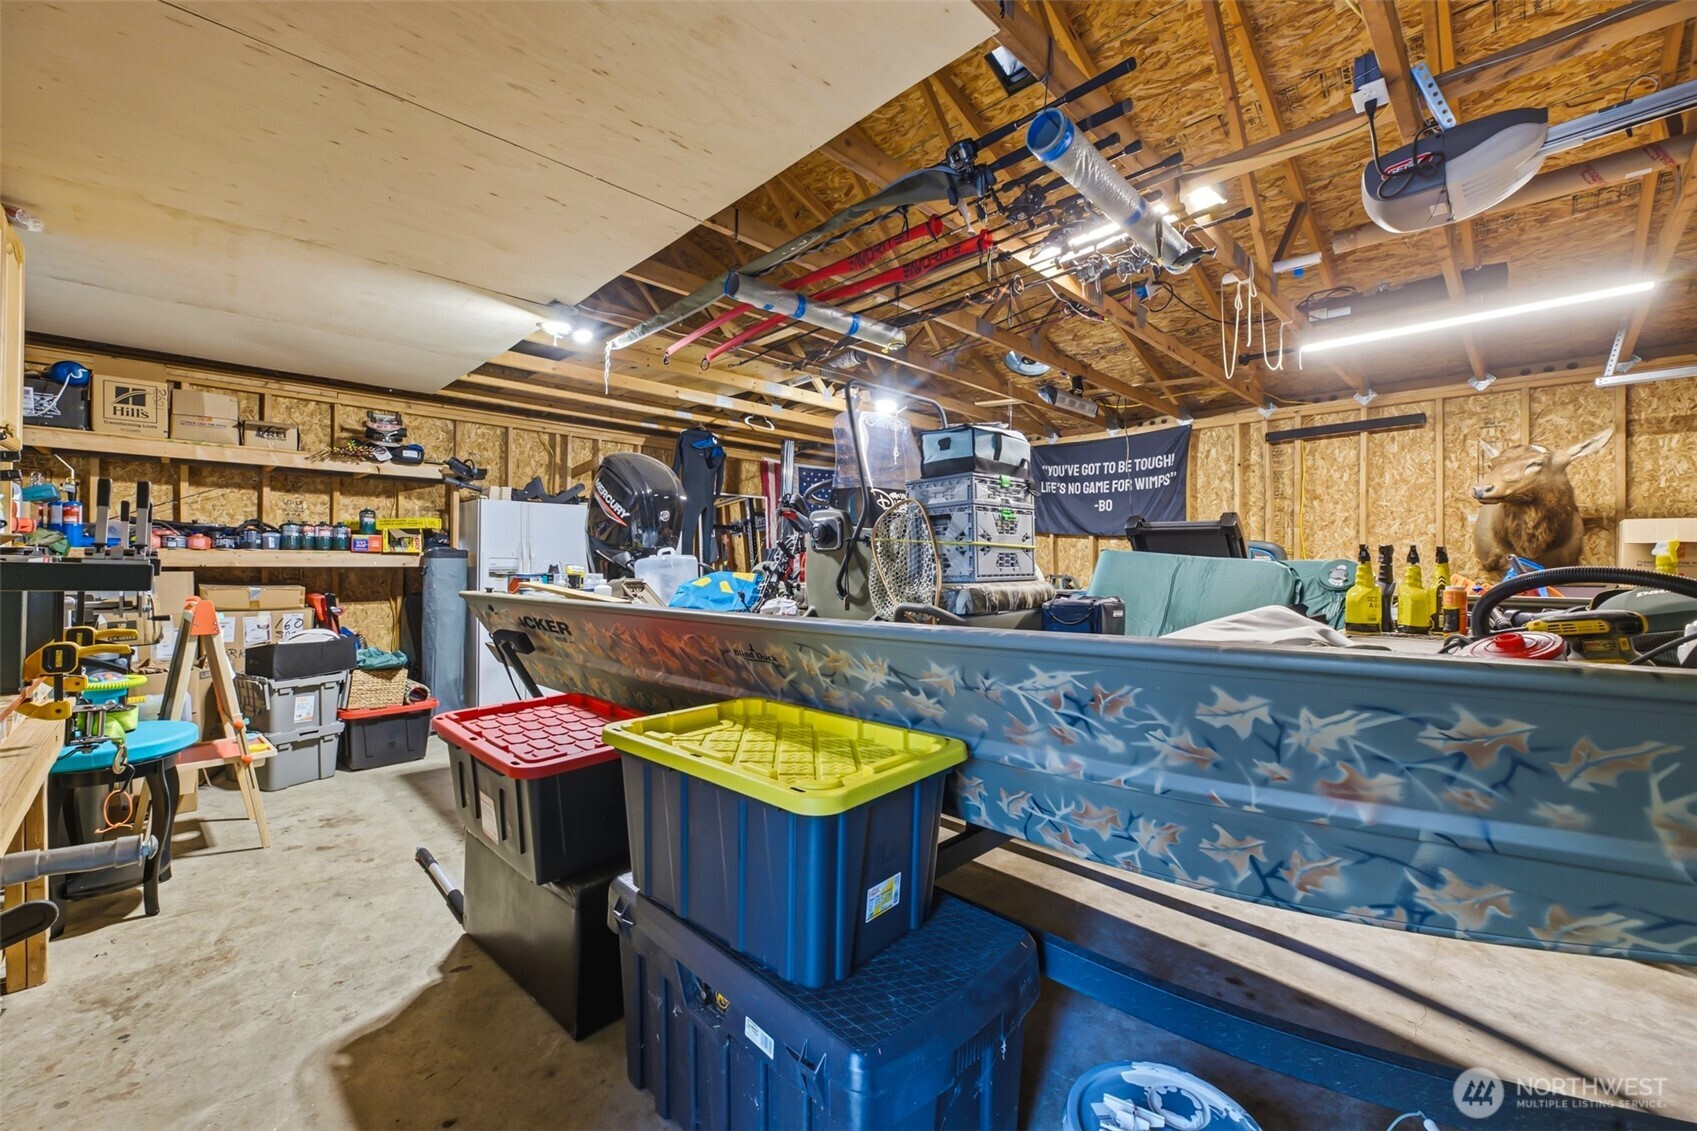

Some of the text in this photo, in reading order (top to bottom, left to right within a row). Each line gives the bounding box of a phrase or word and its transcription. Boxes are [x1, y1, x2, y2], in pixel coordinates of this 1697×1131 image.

[112, 405, 149, 419] Hill's
[1042, 453, 1175, 477] "YOU'VE GOT TO BE TOUGH!
[1041, 471, 1177, 494] LIFE'S NO GAME FOR WIMPS"
[595, 478, 631, 519] MERCURY
[1094, 499, 1113, 512] -BO
[733, 648, 778, 662] Blind Duck
